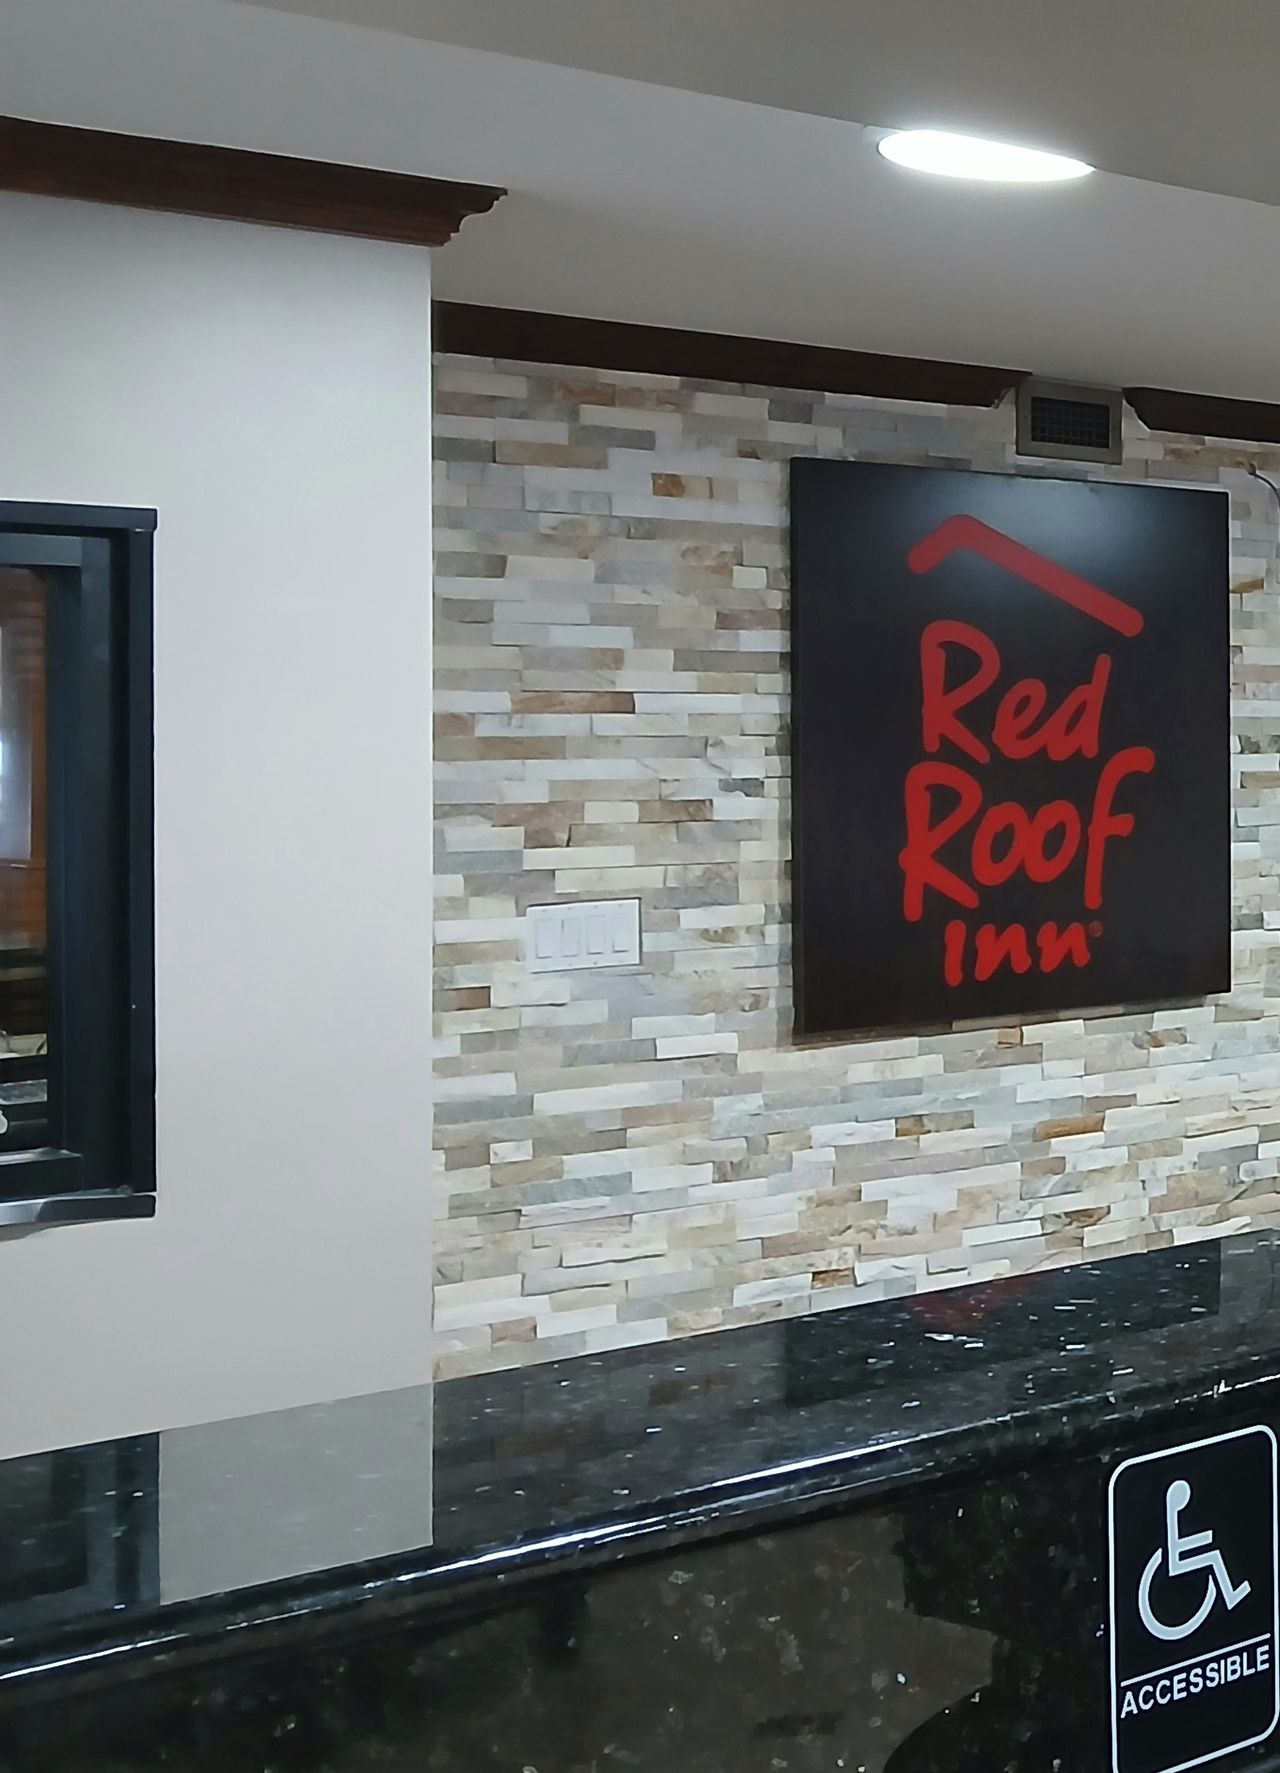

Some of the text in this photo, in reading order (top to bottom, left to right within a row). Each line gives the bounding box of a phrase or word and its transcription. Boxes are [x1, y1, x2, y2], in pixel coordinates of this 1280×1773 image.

[921, 619, 1111, 764] Red
[899, 746, 1155, 922] Roof
[1120, 1645, 1270, 1719] ACCESSIBLE
